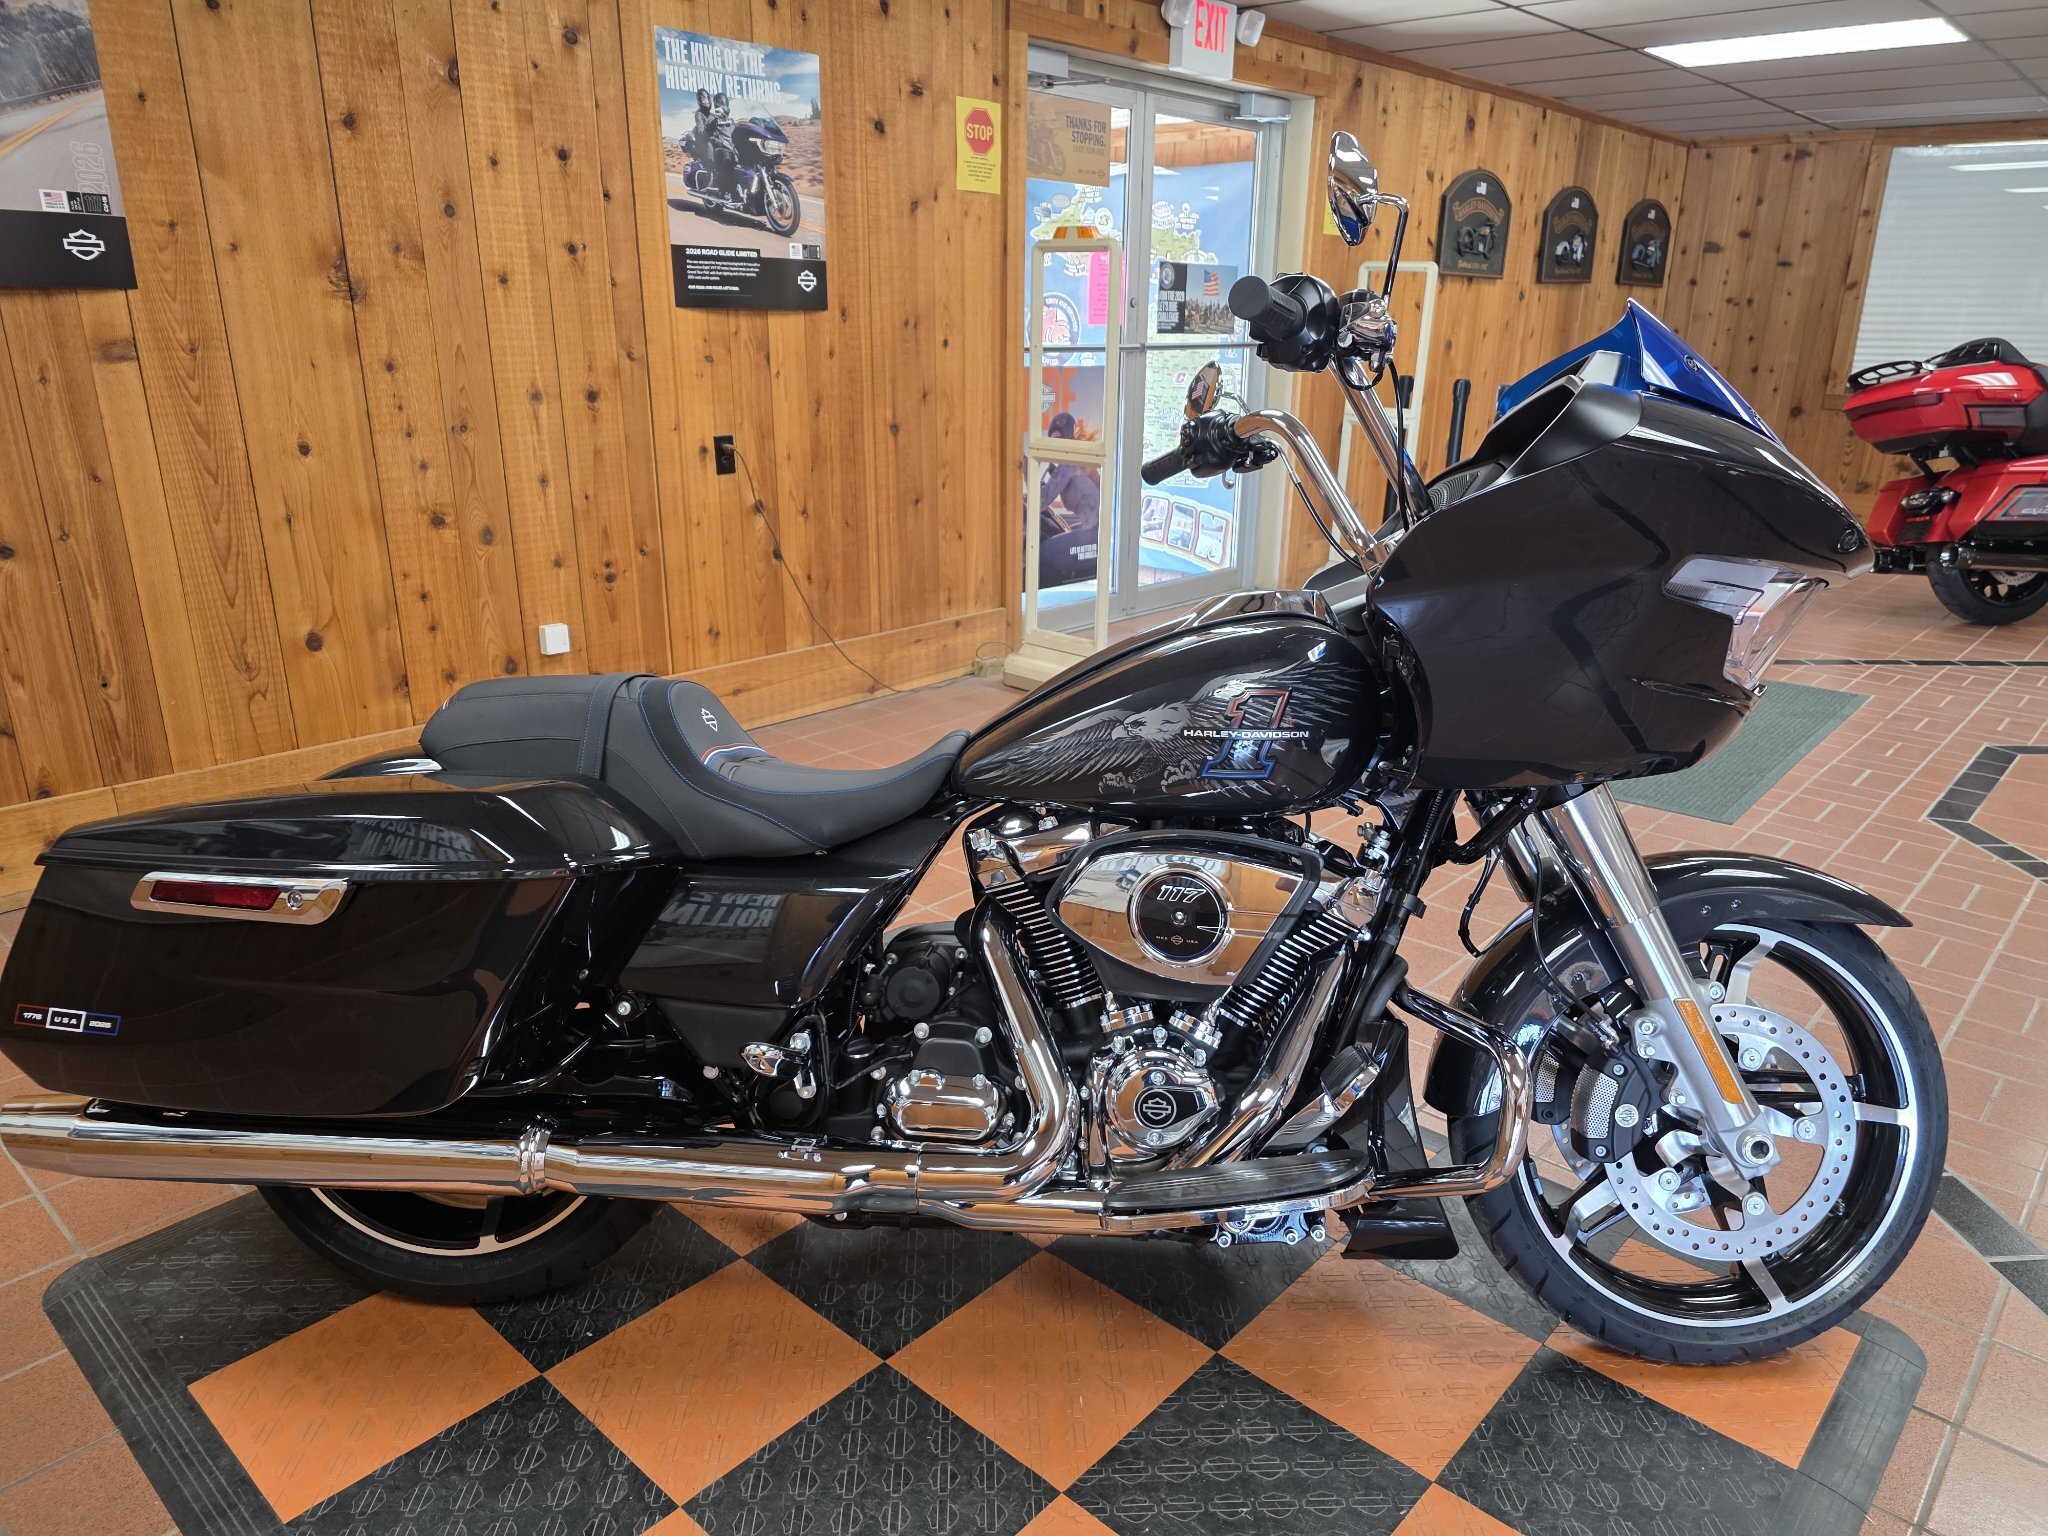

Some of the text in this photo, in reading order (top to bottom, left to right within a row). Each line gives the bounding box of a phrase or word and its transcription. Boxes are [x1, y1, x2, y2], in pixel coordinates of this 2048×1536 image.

[1194, 0, 1228, 53] EXIT
[662, 36, 766, 77] THE KING OF THE
[664, 64, 723, 95] HIGHWAY
[966, 123, 993, 142] STOP
[1066, 115, 1106, 134] THANKS FOR
[1072, 130, 1105, 147] STOPPING.
[1183, 729, 1309, 738] HARLEY-DAVIDSON
[1157, 885, 1206, 903] 117
[53, 1016, 78, 1025] USA
